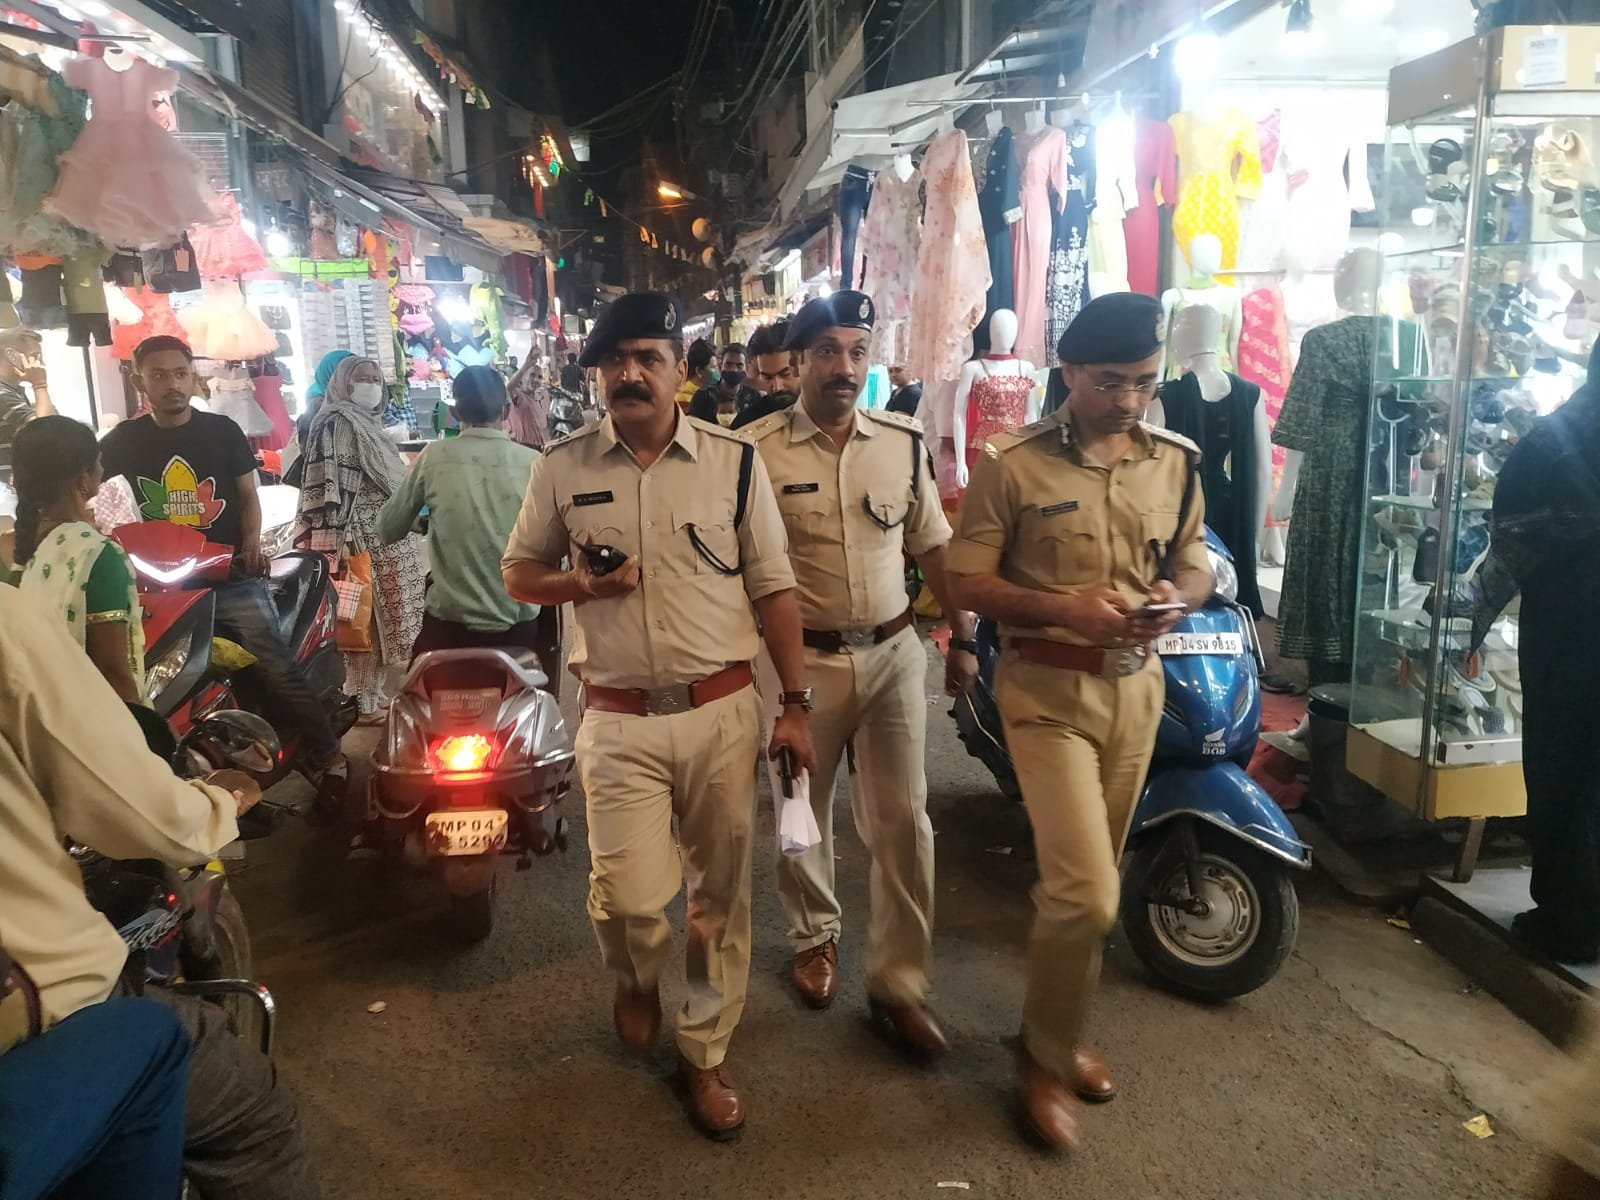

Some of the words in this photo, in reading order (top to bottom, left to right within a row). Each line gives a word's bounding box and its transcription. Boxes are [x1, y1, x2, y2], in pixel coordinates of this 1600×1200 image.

[169, 491, 197, 503] HIGH
[162, 503, 206, 516] SPIRITS
[1165, 639, 1179, 651] MP
[1196, 639, 1209, 650] SW
[440, 819, 467, 833] MP
[471, 818, 494, 831] 04
